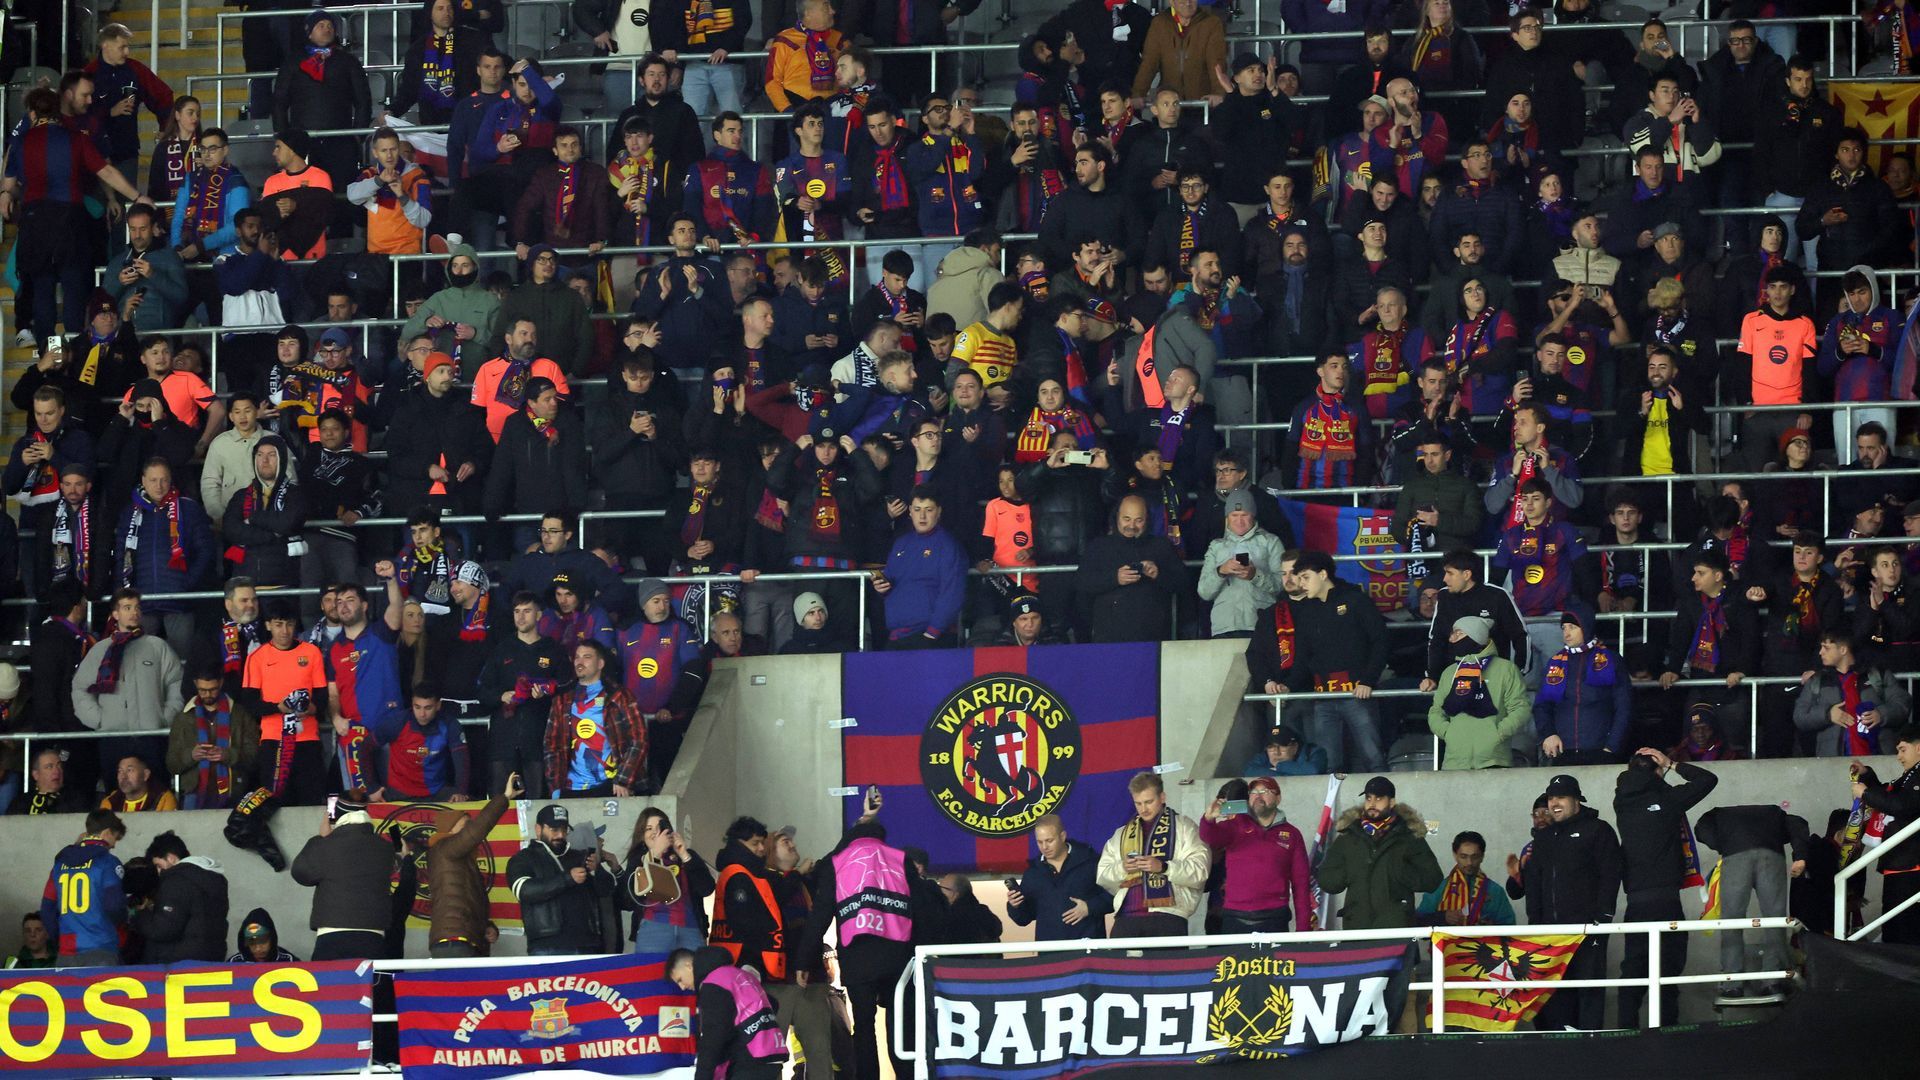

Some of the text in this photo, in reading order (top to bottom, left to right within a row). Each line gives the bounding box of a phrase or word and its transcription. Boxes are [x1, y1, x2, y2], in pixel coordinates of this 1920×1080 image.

[936, 682, 1064, 735] WARRIORS
[929, 752, 950, 765] 18
[1052, 745, 1075, 760] 99
[937, 784, 1066, 832] F.C. BARCELONA
[1151, 837, 1168, 858] FC
[58, 872, 90, 914] 10
[861, 893, 877, 902] FAN
[876, 896, 908, 910] SUPPORT
[855, 912, 884, 932] 022
[1211, 955, 1296, 983] Nostra
[0, 967, 323, 1063] OSES
[454, 975, 644, 1044] PEÑA BARCELONISTA
[433, 1035, 662, 1067] ALHAMA DE MURCIA
